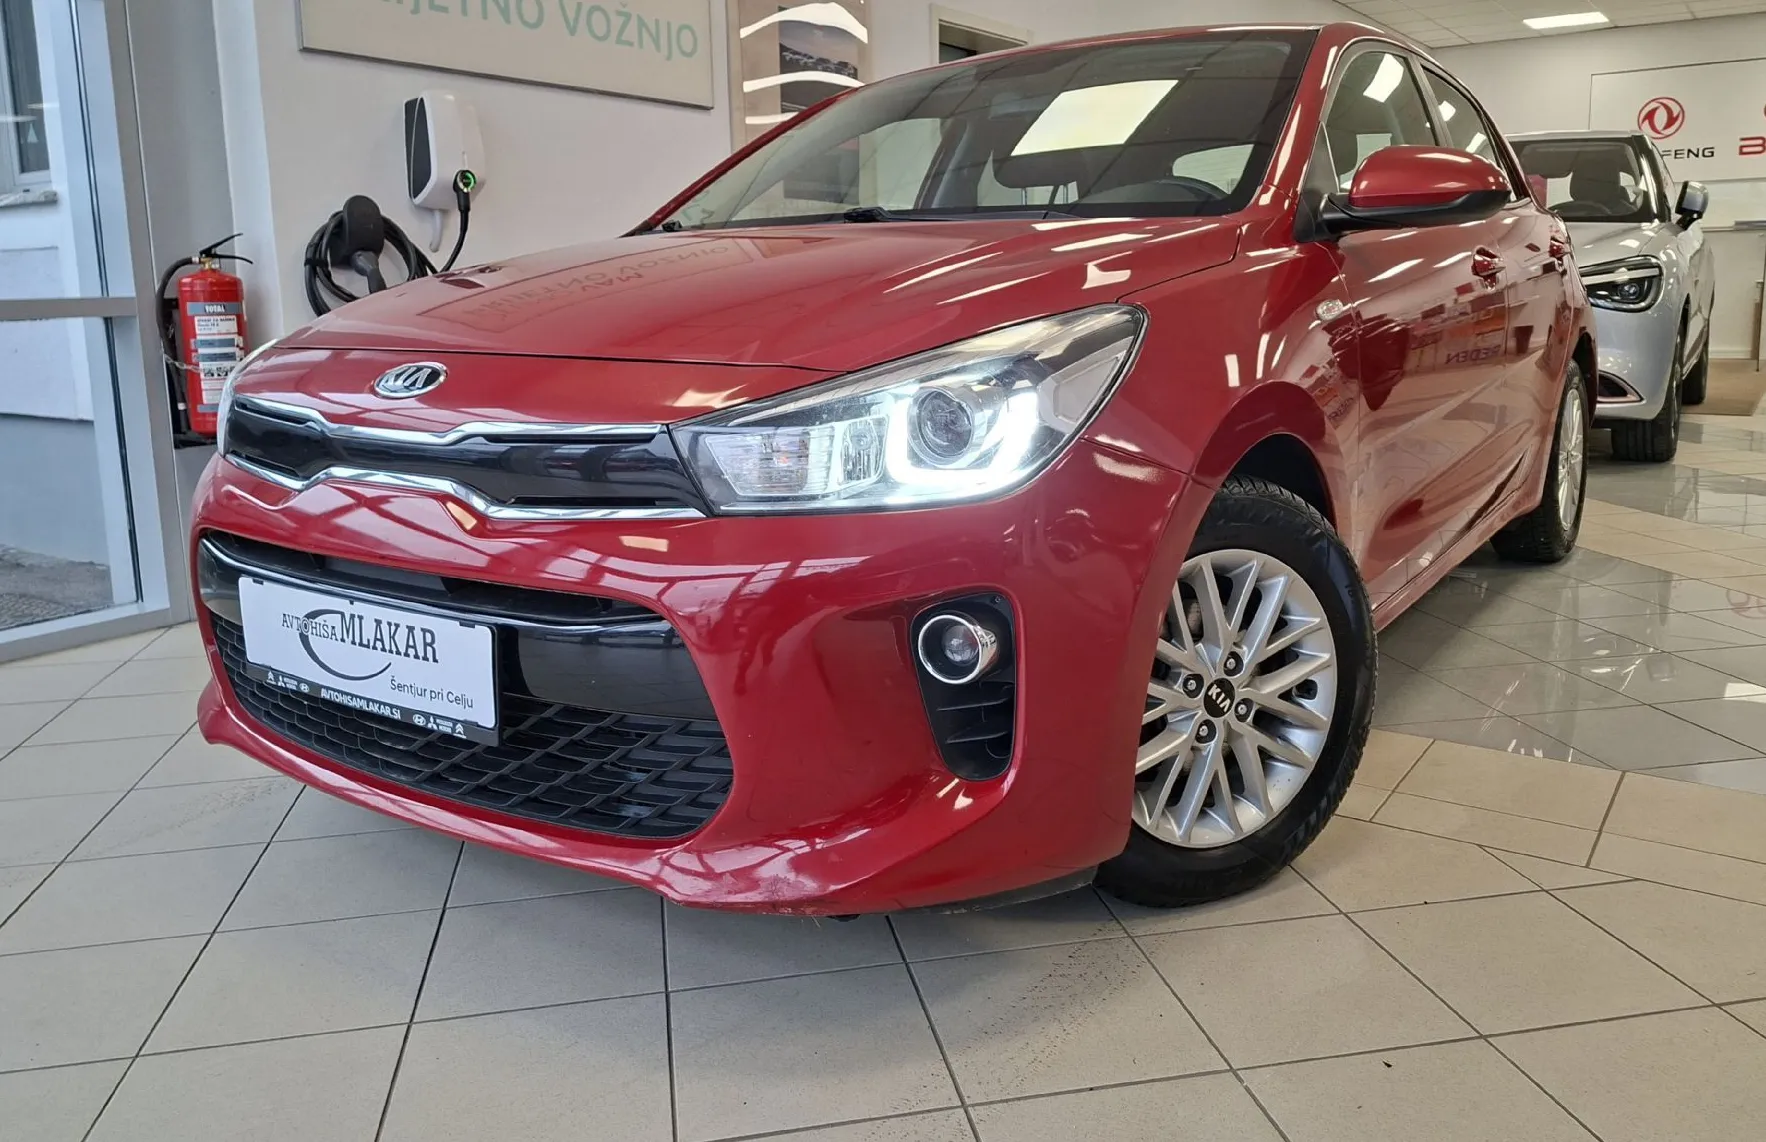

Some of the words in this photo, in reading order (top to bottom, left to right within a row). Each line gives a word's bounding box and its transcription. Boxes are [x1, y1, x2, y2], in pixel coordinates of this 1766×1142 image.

[558, 0, 699, 61] VOŽNJO
[281, 612, 339, 642] AVTOHIŠA
[340, 611, 439, 664] MLAKAR
[390, 675, 428, 698] Šentjur
[429, 687, 444, 703] pri
[446, 690, 475, 710] Celju
[1207, 683, 1231, 713] KIA
